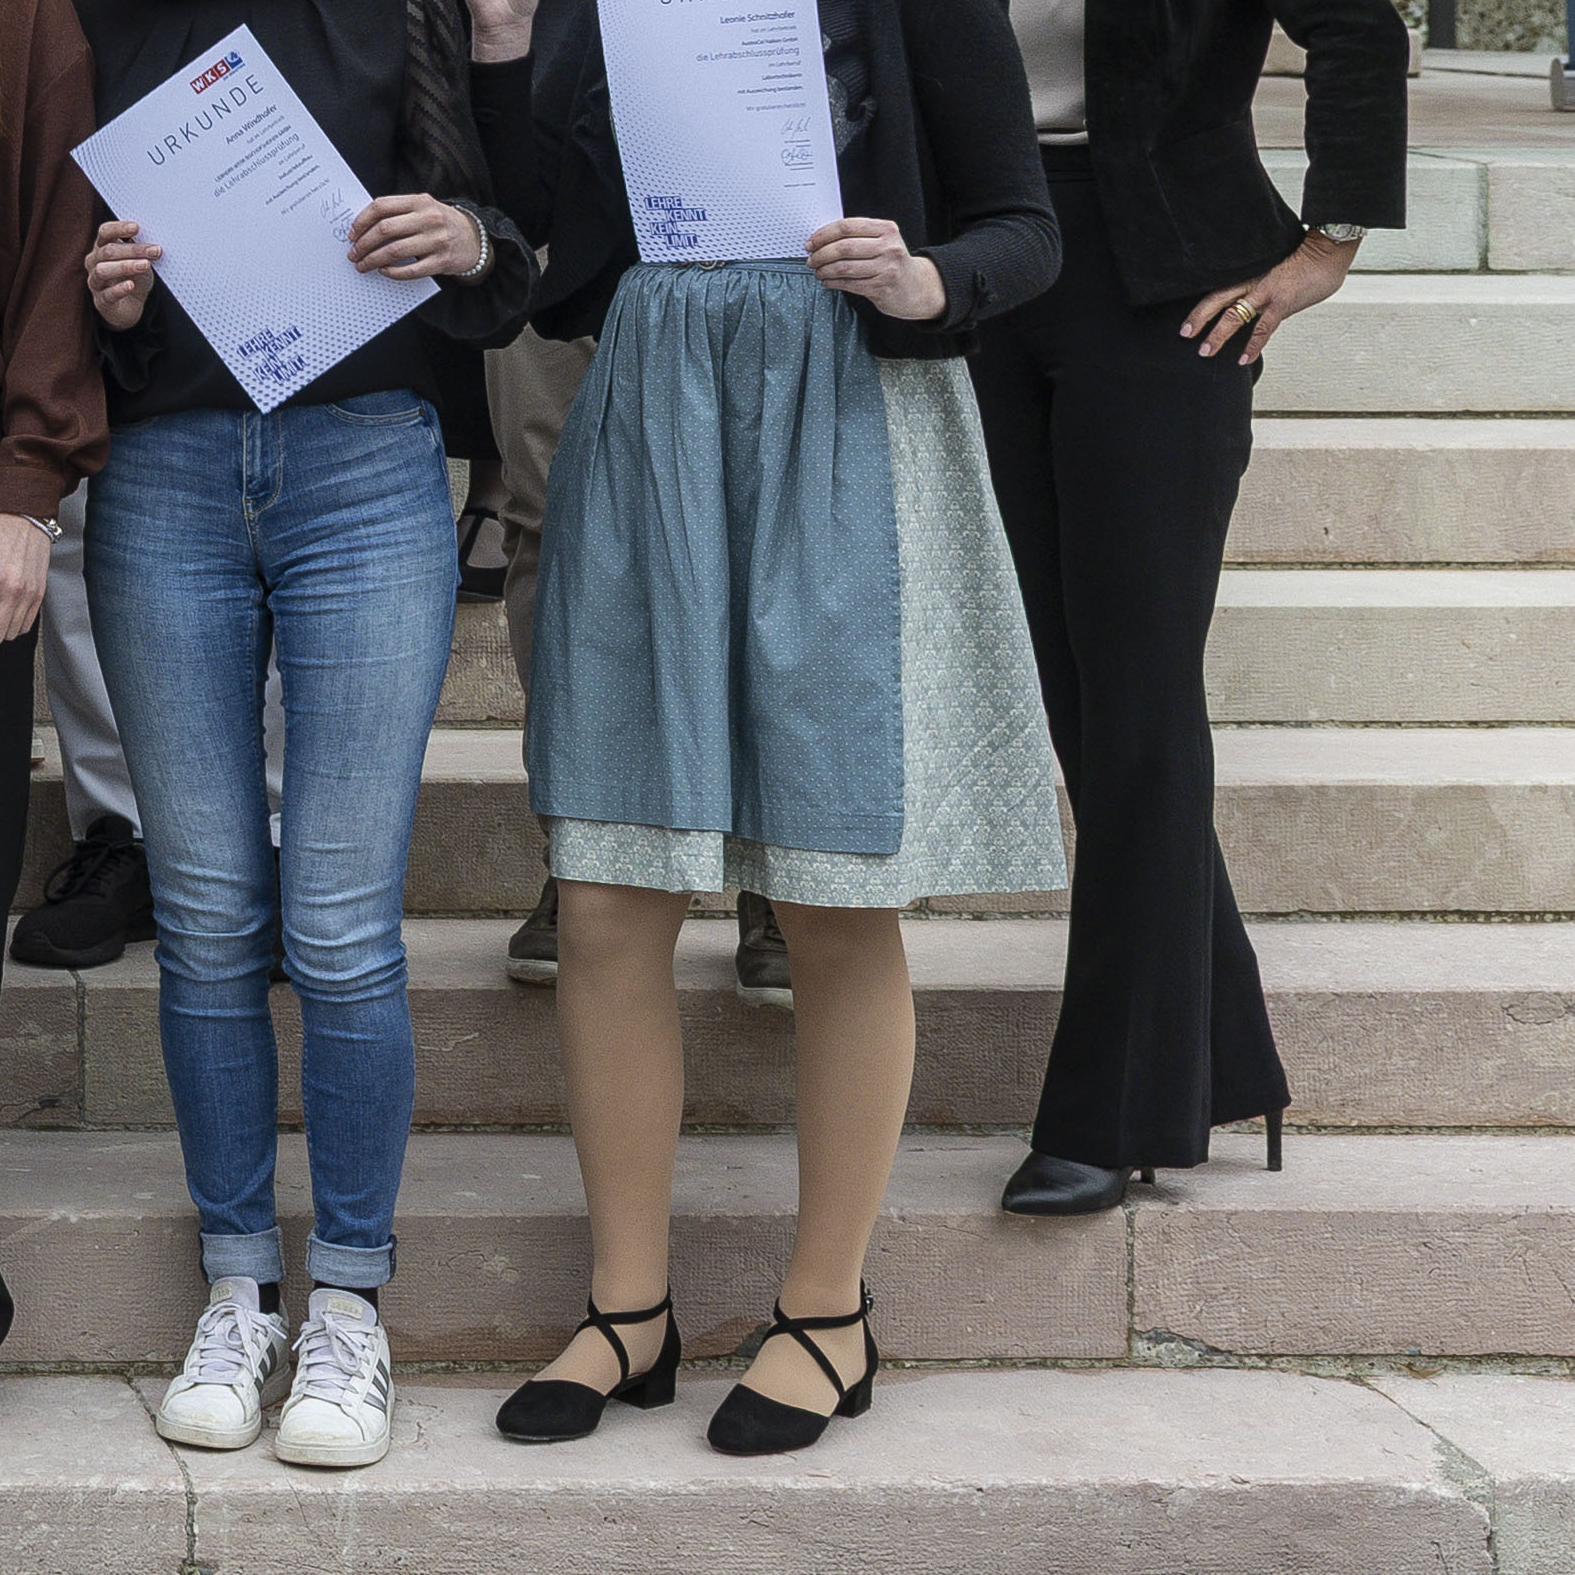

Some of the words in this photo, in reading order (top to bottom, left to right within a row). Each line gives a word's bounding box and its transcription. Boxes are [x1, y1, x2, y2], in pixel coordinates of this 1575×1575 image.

[719, 14, 746, 25] Leonie
[190, 59, 230, 93] WKS
[145, 73, 264, 167] URKUNDE
[223, 126, 245, 145] Anna
[240, 102, 278, 133] Windhofer
[644, 196, 682, 210] LEHRE
[665, 208, 707, 222] KENNT
[649, 221, 678, 235] KEIN
